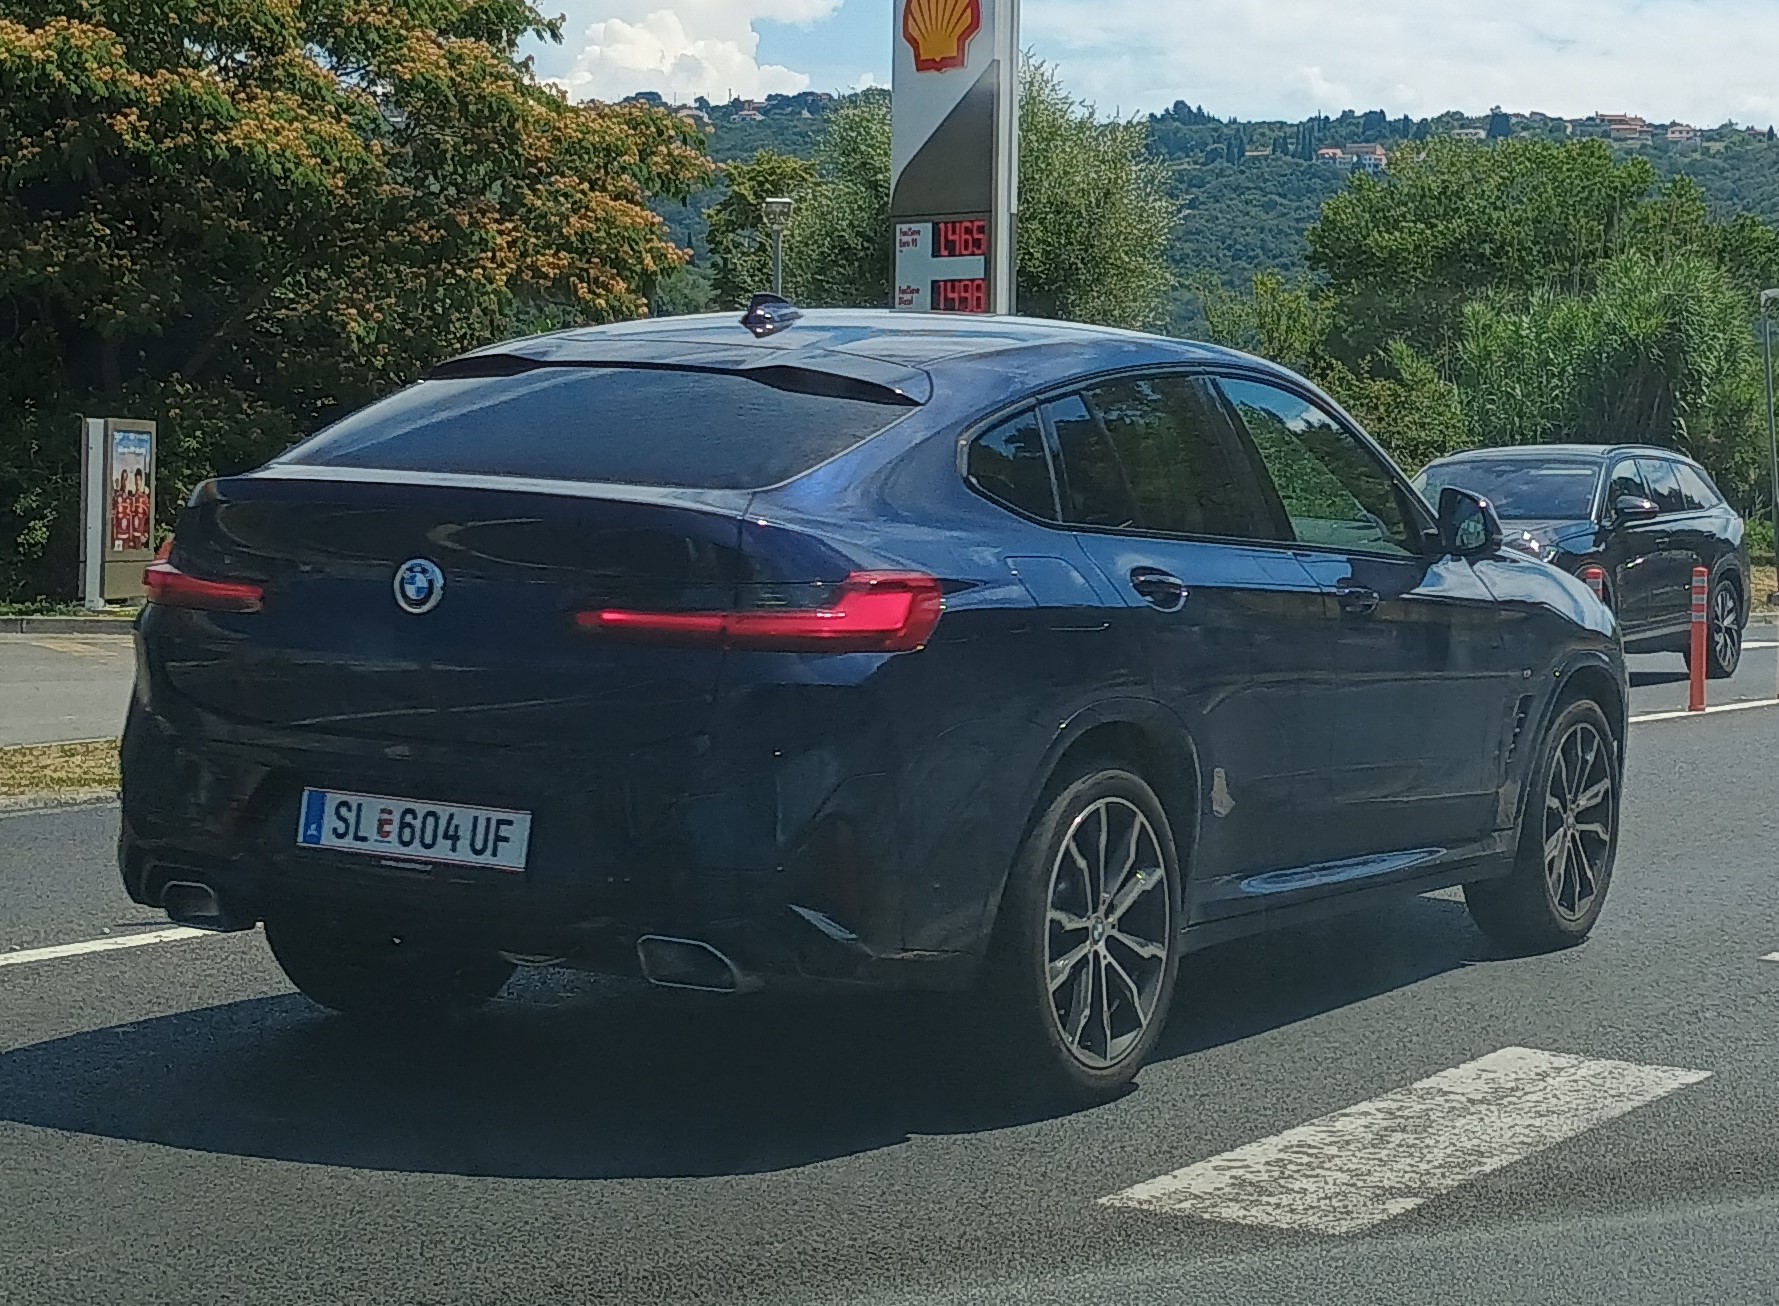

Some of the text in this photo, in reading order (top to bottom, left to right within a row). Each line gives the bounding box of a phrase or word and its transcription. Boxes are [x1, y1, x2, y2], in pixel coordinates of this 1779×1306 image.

[332, 801, 515, 858] SL 604 UF
